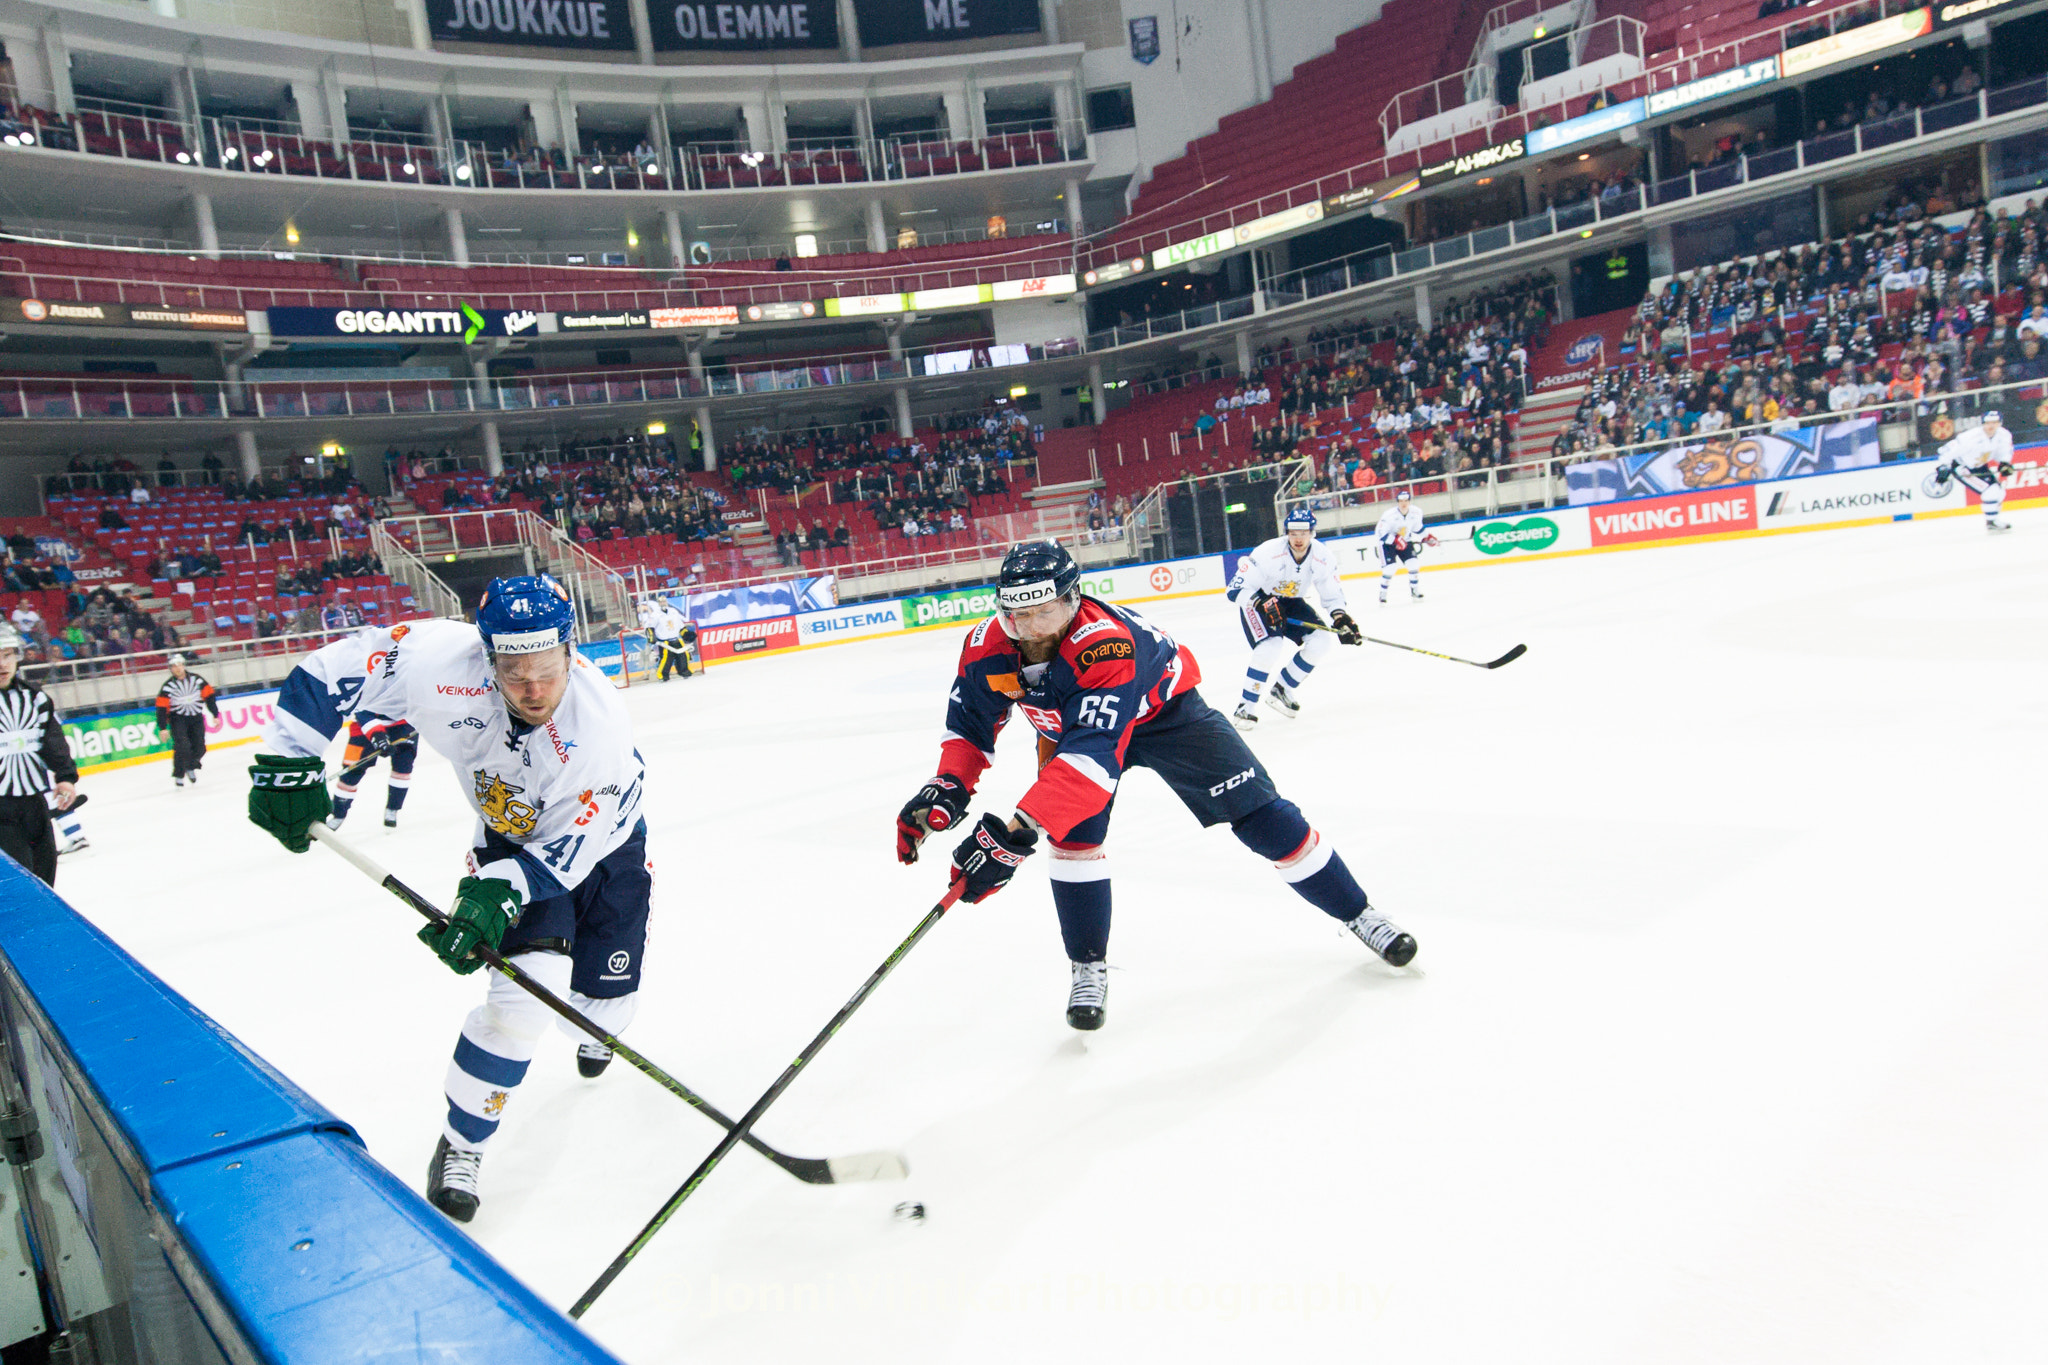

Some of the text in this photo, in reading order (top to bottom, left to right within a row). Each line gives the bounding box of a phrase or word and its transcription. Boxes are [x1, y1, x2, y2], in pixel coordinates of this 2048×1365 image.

[446, 0, 611, 38] JOUKKUE
[674, 4, 811, 39] OLEMME
[924, 0, 970, 30] ME
[1168, 234, 1220, 264] LYYTI
[335, 310, 463, 334] GIGANTTI
[1801, 488, 1912, 513] LAAKKONEN
[1594, 498, 1749, 536] VIKING LINE
[1479, 525, 1553, 548] Specsavers
[1177, 568, 1196, 584] OP
[510, 598, 530, 613] 41
[917, 594, 997, 624] planex
[701, 619, 793, 647] WARRIOR
[812, 610, 897, 633] BILTEMA
[497, 638, 556, 651] FINNAIR
[1081, 642, 1132, 665] Orange
[1077, 695, 1121, 730] 65
[544, 716, 570, 764] EIKKAUS
[253, 768, 326, 787] CCM
[1208, 766, 1256, 798] CCM
[542, 834, 586, 873] 41
